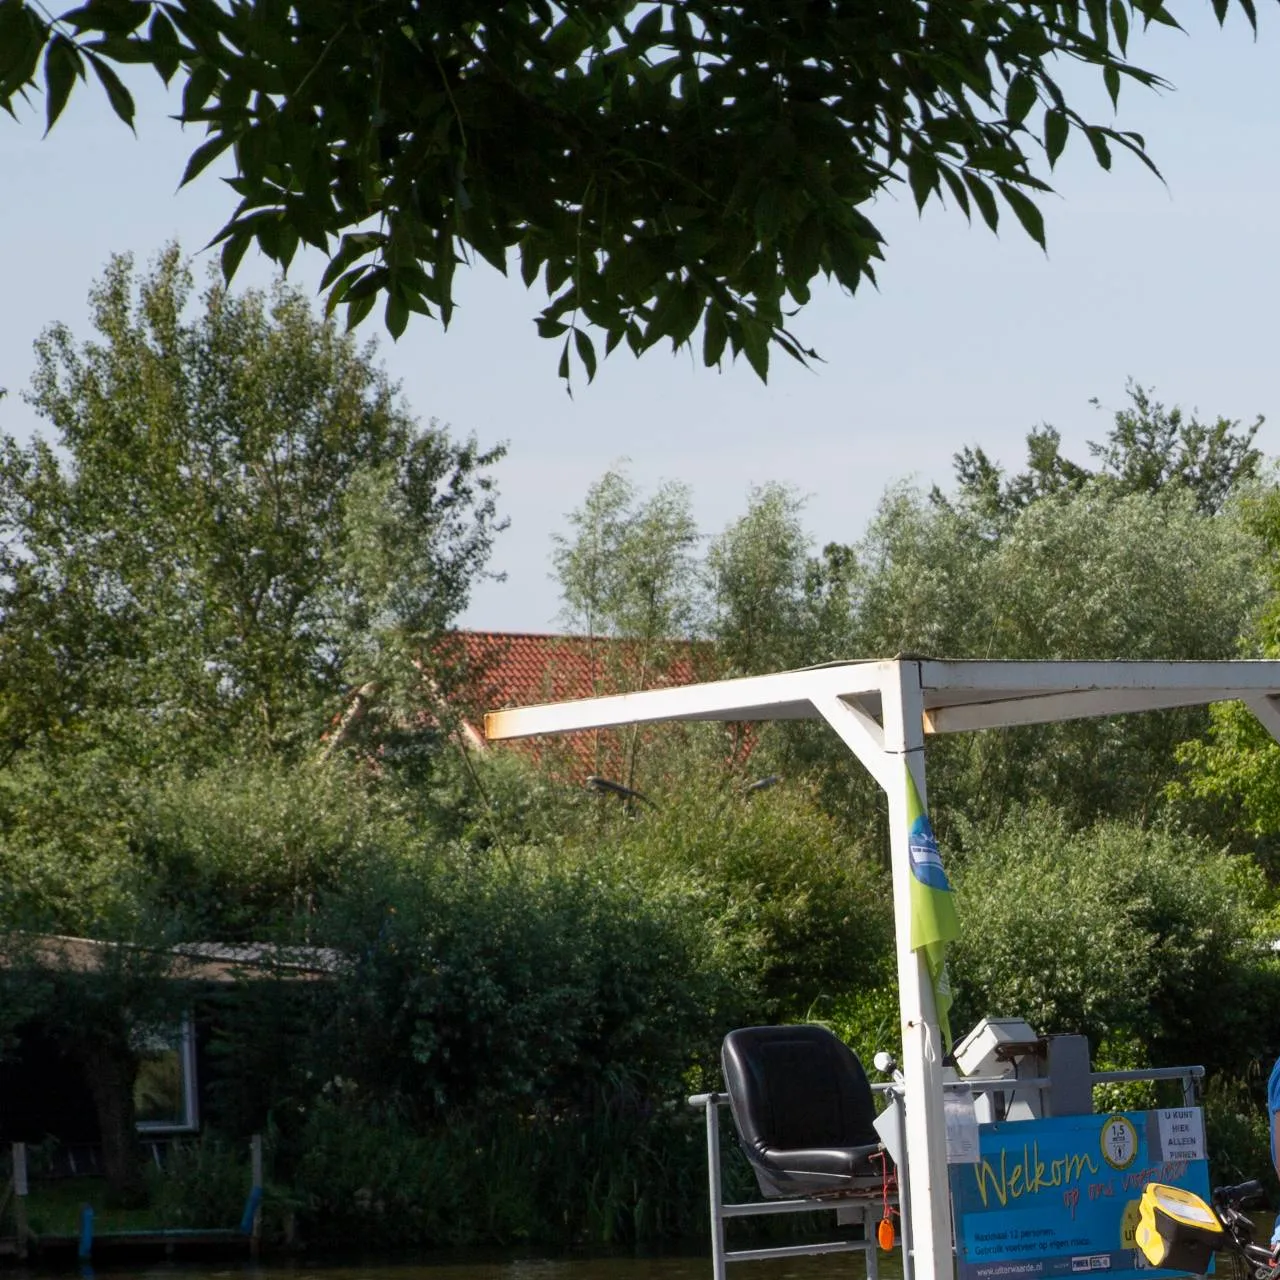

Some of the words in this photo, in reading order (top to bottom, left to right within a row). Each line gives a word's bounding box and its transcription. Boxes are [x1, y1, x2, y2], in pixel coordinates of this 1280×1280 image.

[1164, 1111, 1171, 1119] U
[1172, 1111, 1193, 1119] KUNT
[1112, 1124, 1125, 1137] 1,5
[1172, 1124, 1190, 1132] HIER
[1168, 1137, 1196, 1146] ALLEEN
[974, 1140, 1099, 1208] Welkom
[1038, 1242, 1048, 1252] op
